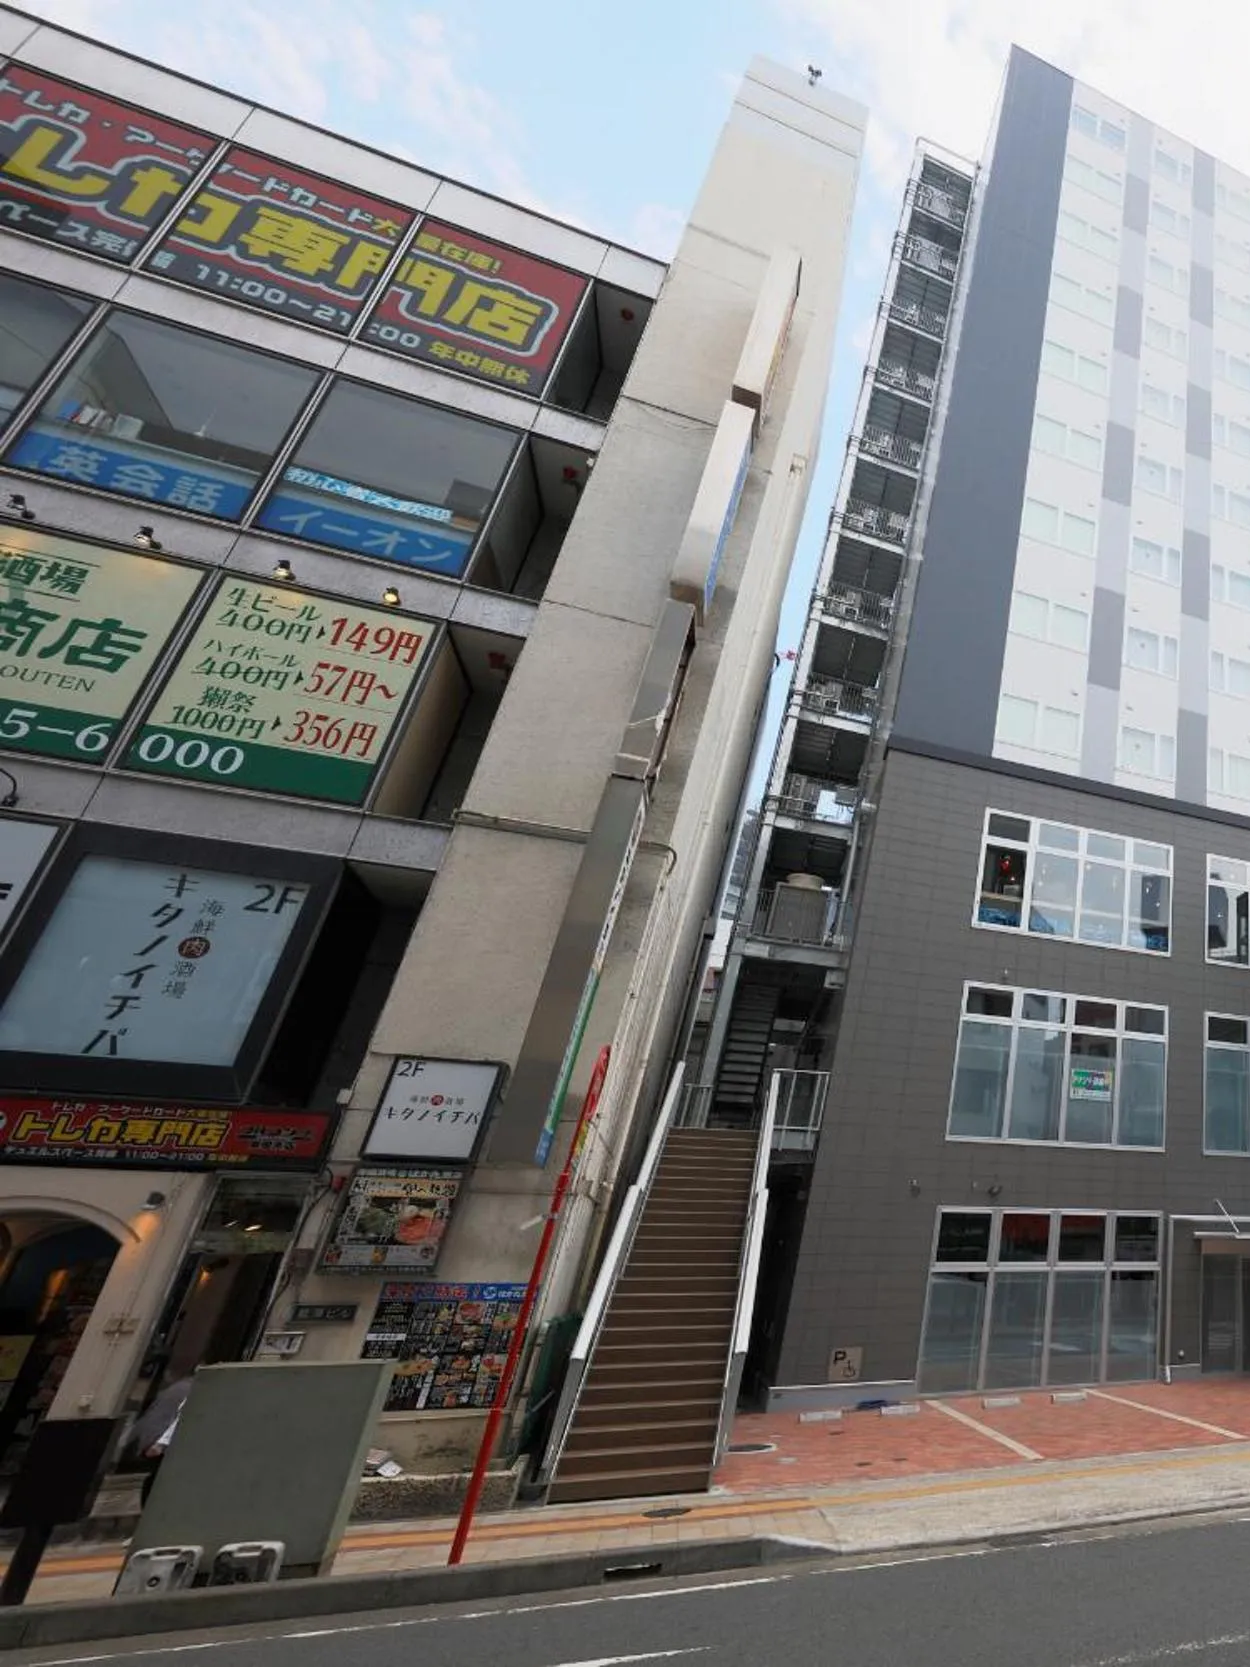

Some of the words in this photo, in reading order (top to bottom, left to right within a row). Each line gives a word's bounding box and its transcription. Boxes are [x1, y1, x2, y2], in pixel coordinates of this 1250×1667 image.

[47, 445, 225, 513] 英会話
[279, 510, 453, 563] イーオン
[203, 639, 299, 668] ハイボール
[216, 608, 312, 644] 400円
[328, 617, 423, 664] 149円
[192, 656, 290, 691] 400円
[168, 704, 267, 740] 1000円
[283, 710, 379, 757] 356円
[243, 884, 306, 915] 2F
[81, 873, 199, 1055] キタノイチバ
[397, 1061, 426, 1077] 2F
[11, 1112, 228, 1148] トレカ専門店
[833, 1351, 847, 1366] P
